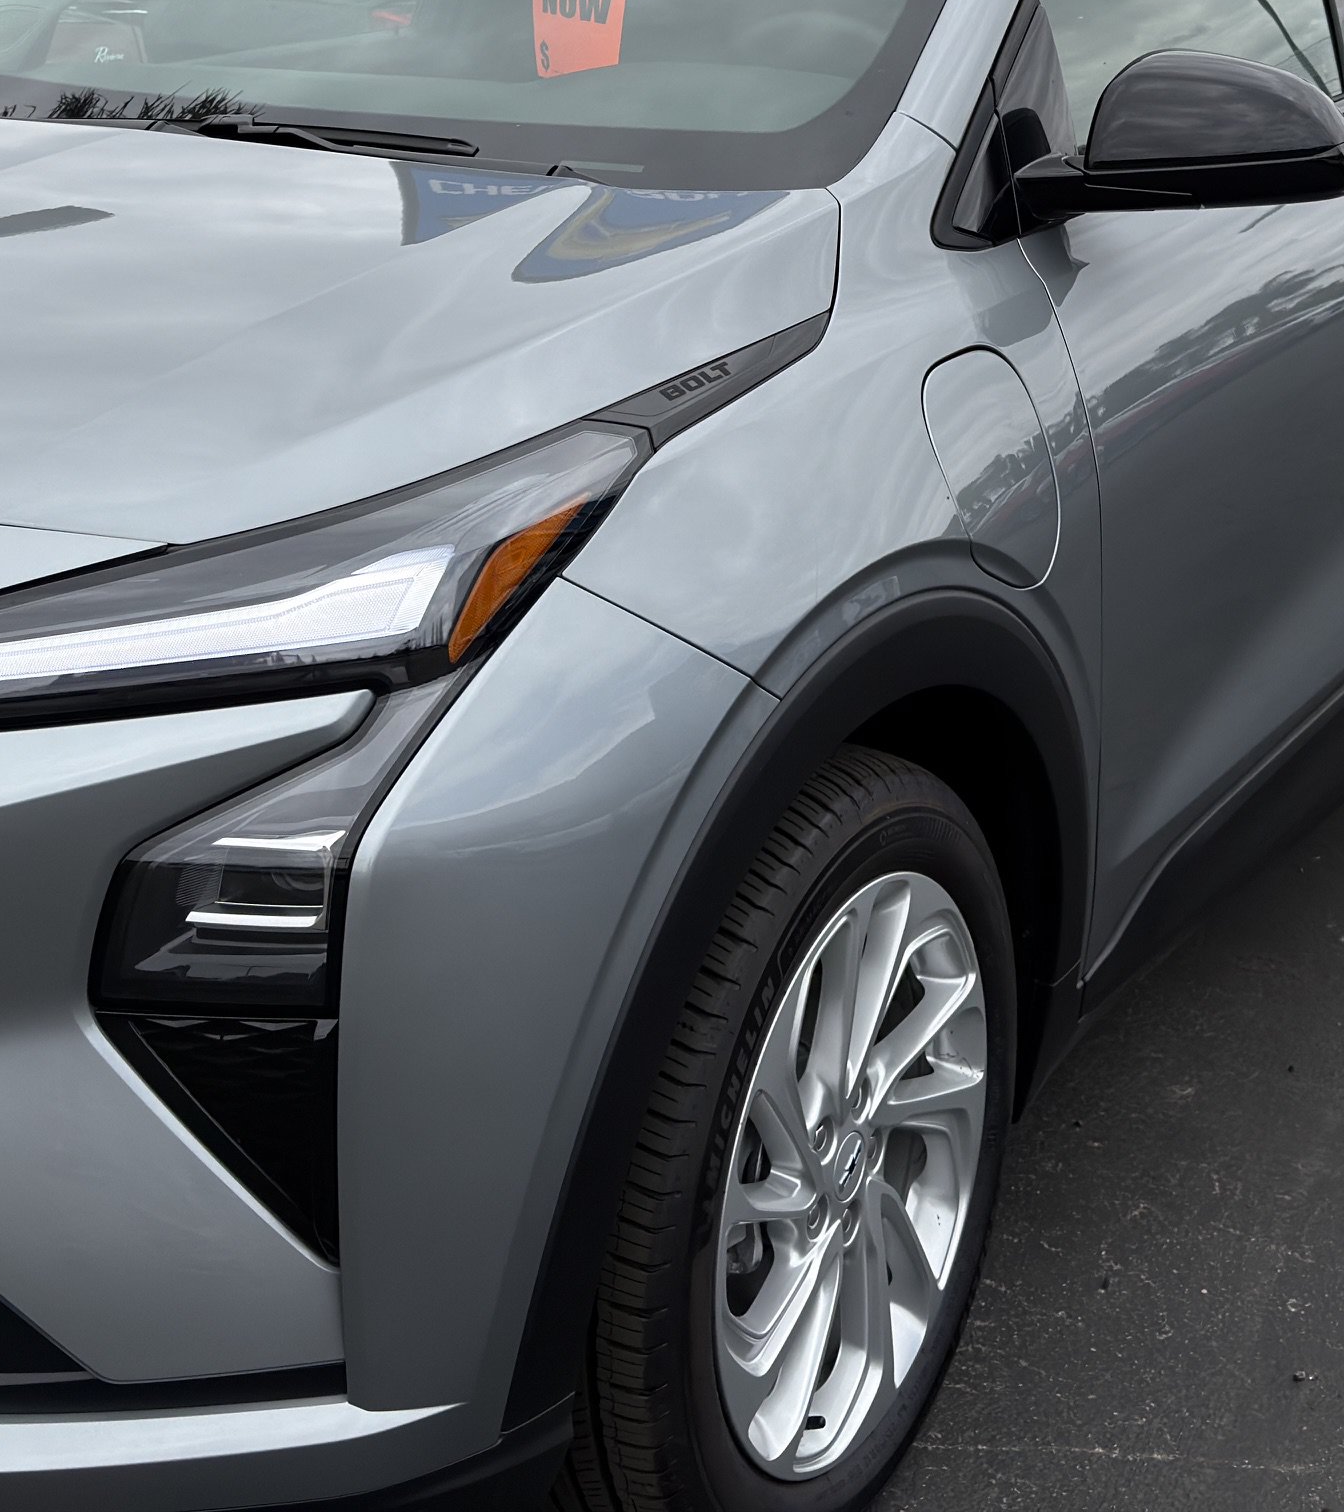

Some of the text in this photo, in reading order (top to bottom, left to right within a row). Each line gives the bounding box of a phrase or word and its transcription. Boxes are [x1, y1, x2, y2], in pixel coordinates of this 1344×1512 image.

[540, 40, 550, 72] $
[659, 362, 731, 401] BOLT
[705, 977, 774, 1191] MICHELIN
